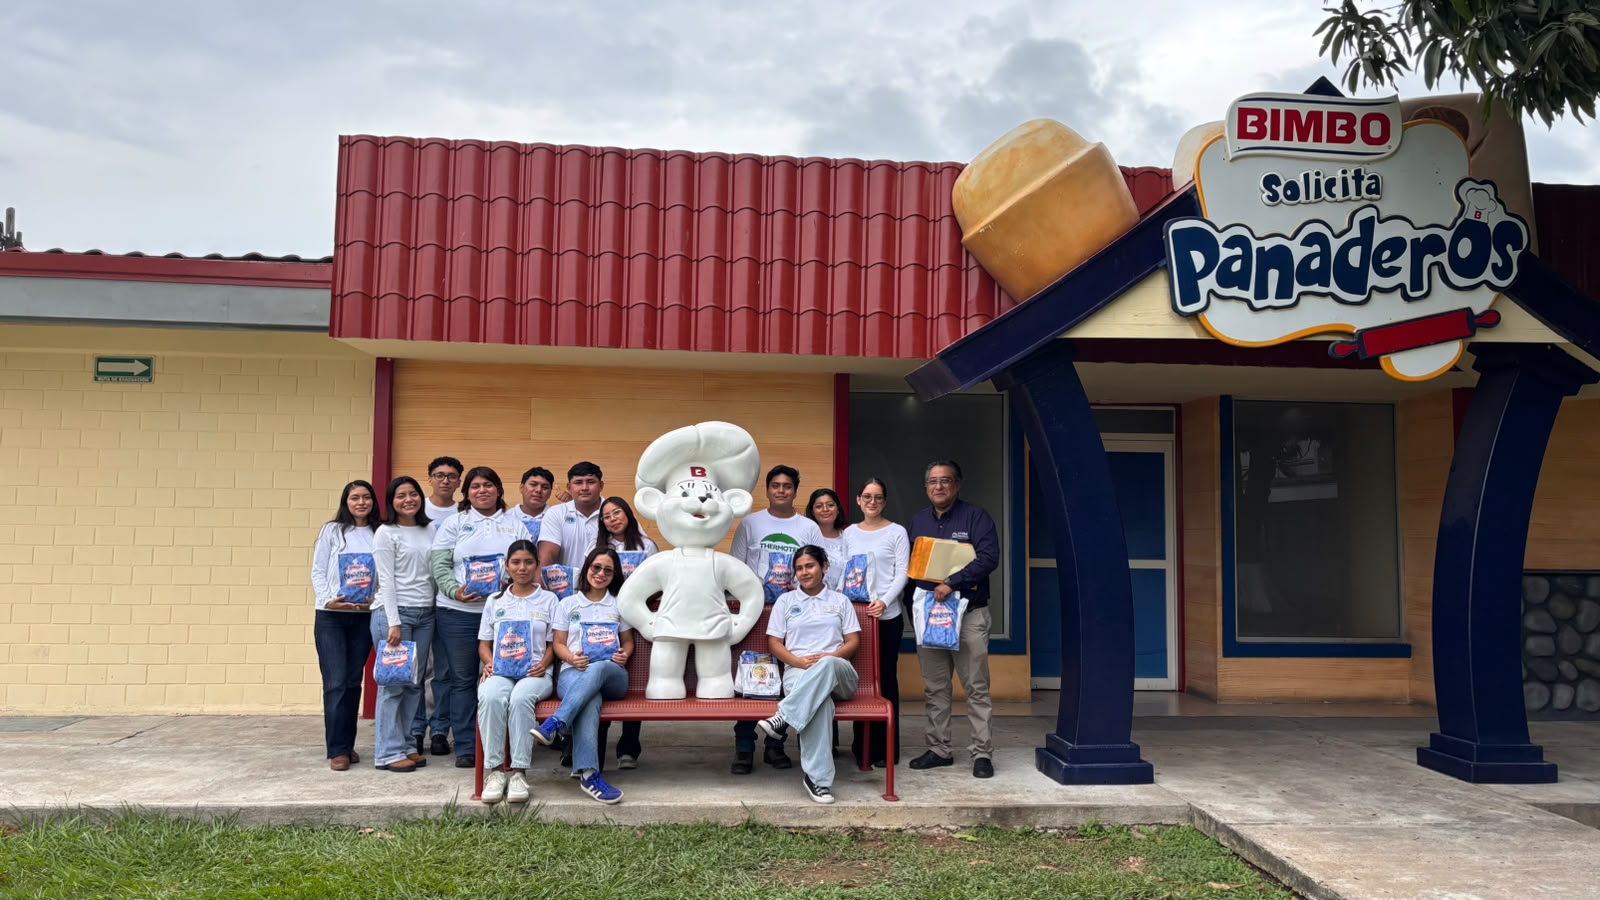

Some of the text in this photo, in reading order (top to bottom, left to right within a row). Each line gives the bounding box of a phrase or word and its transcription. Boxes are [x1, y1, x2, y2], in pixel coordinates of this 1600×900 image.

[1236, 106, 1391, 146] BIMBO
[1262, 168, 1381, 202] Solicita
[1473, 210, 1483, 219] B
[1170, 215, 1524, 307] Panaderos
[690, 466, 706, 478] B
[760, 543, 800, 553] THERMOTE
